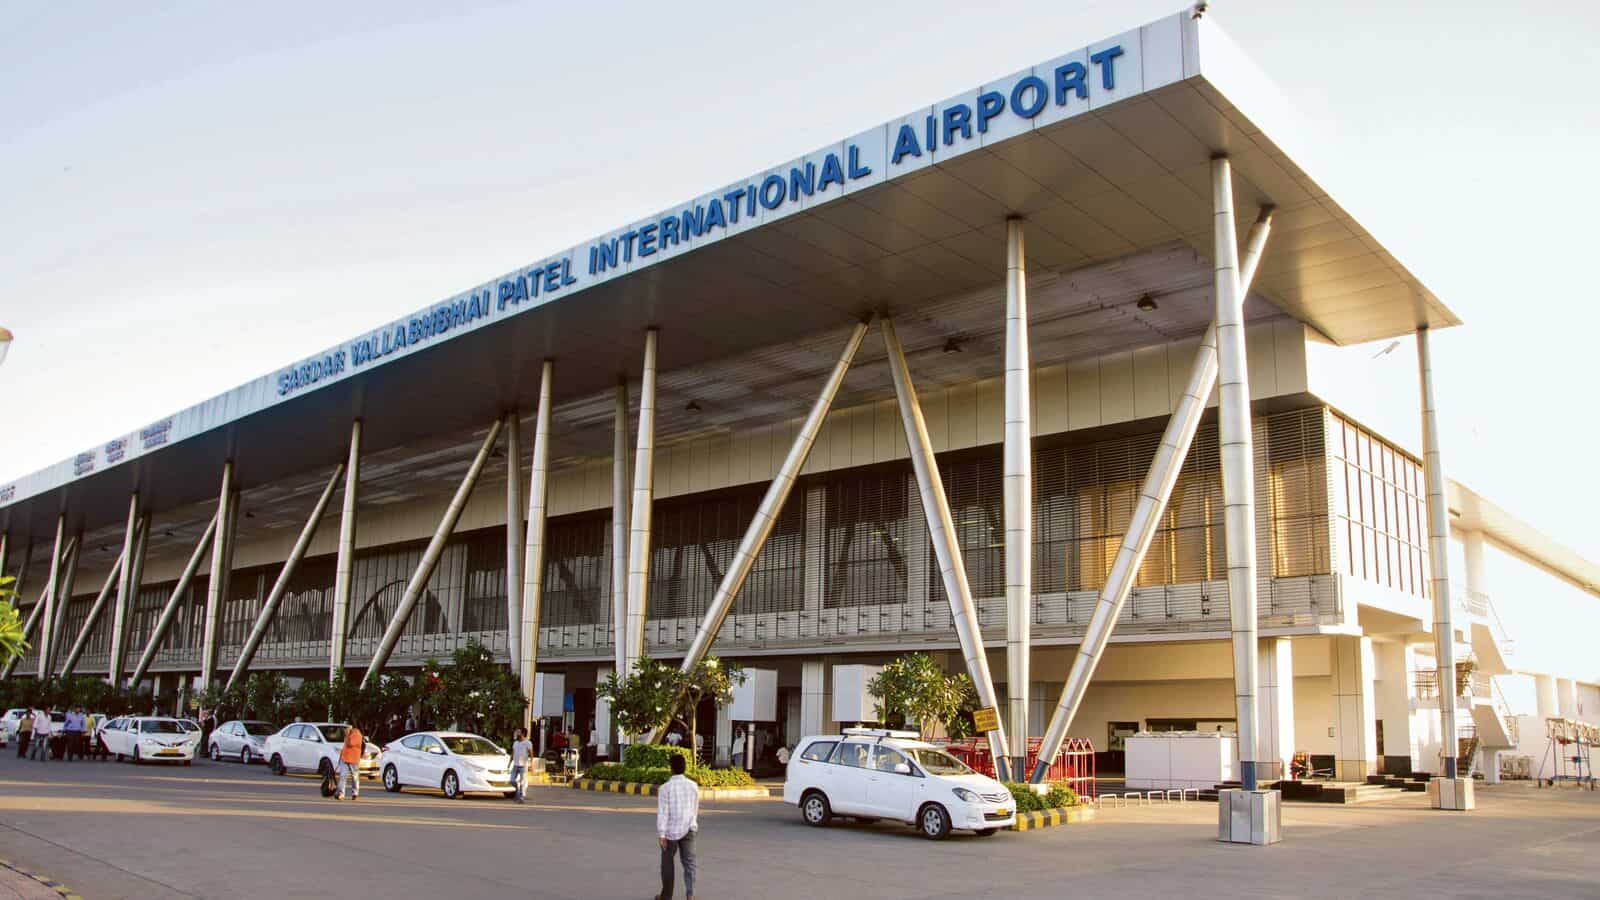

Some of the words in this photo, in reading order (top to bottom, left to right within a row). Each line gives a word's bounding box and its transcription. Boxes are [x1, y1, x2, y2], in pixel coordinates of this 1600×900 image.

[277, 350, 345, 395] SARDAR
[351, 291, 490, 366] VALLABHBHAI
[496, 257, 576, 310] PATEL
[589, 144, 871, 275] INTERNATIONAL
[891, 45, 1123, 164] AIRPORT
